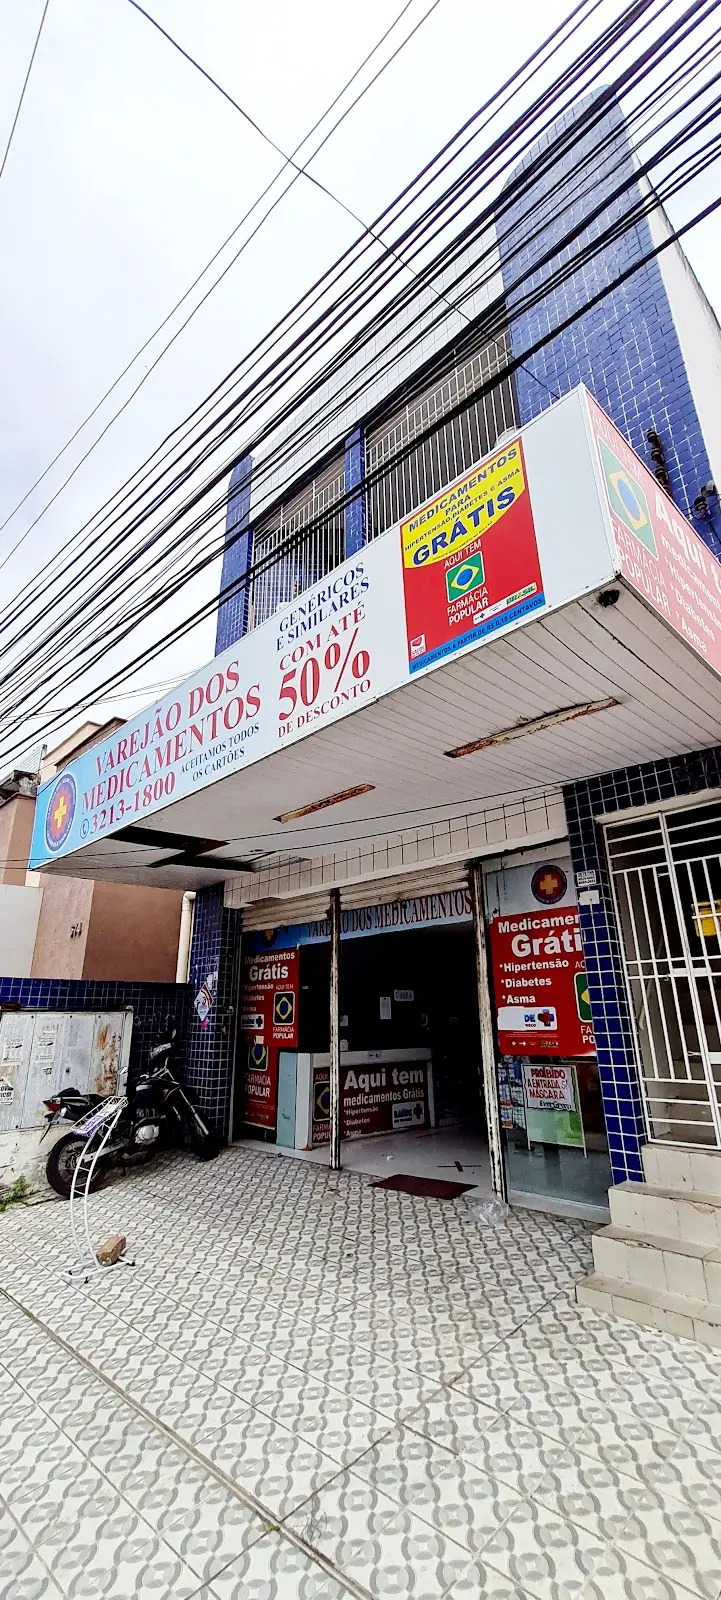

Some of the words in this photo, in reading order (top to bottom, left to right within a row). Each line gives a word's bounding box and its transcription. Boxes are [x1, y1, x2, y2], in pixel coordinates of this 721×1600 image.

[409, 448, 517, 533] MEDICAMENTOS
[497, 468, 520, 487] ASMA
[445, 494, 471, 516] PARA
[412, 486, 516, 566] GRÁTIS
[655, 490, 708, 577] Aqui
[444, 551, 462, 569] AQUI
[464, 539, 481, 555] TEM
[611, 518, 667, 590] FARMÁCIA
[279, 562, 364, 632] GENÉRICOS
[616, 543, 671, 616] POPULAR
[276, 638, 284, 651] E
[287, 576, 369, 644] SIMILARES
[446, 587, 488, 616] FARMÁCIA
[448, 597, 488, 626] POPULAR
[674, 587, 715, 641] Diabetes
[279, 633, 321, 671] COM
[326, 604, 366, 642] ATÉ
[412, 646, 451, 670] MEDICAMENTOS
[457, 632, 477, 648] PARTIR
[478, 628, 485, 636] DE
[509, 597, 543, 619] CENTAVOS
[681, 617, 707, 654] Asma
[278, 627, 370, 721] 50%
[96, 702, 182, 777] VAREJÃO
[188, 660, 240, 720] DOS
[278, 721, 293, 738] DE
[297, 679, 371, 728] DESCONTO
[81, 684, 261, 815] MEDICAMENTOS
[180, 743, 227, 775] ACEITAMOS
[229, 722, 260, 746] TODOS
[192, 769, 203, 782] OS
[204, 746, 245, 776] CARTÕES
[89, 771, 176, 835] 3213-1800
[352, 907, 372, 932] DOS
[374, 890, 472, 928] MEDICAMENTOS
[244, 951, 295, 965] Medicamentos
[511, 927, 583, 957] Gráti
[249, 963, 289, 981] Grátis
[503, 958, 569, 973] Hipertensão
[505, 977, 552, 988] Diabetes
[507, 995, 536, 1004] Asma
[343, 1067, 387, 1093] Aqui
[391, 1068, 424, 1086] tem
[343, 1091, 401, 1107] medicamentos
[402, 1087, 425, 1100] Grátis
[346, 1106, 379, 1116] Hipertensão
[346, 1118, 371, 1126] Diabetes
